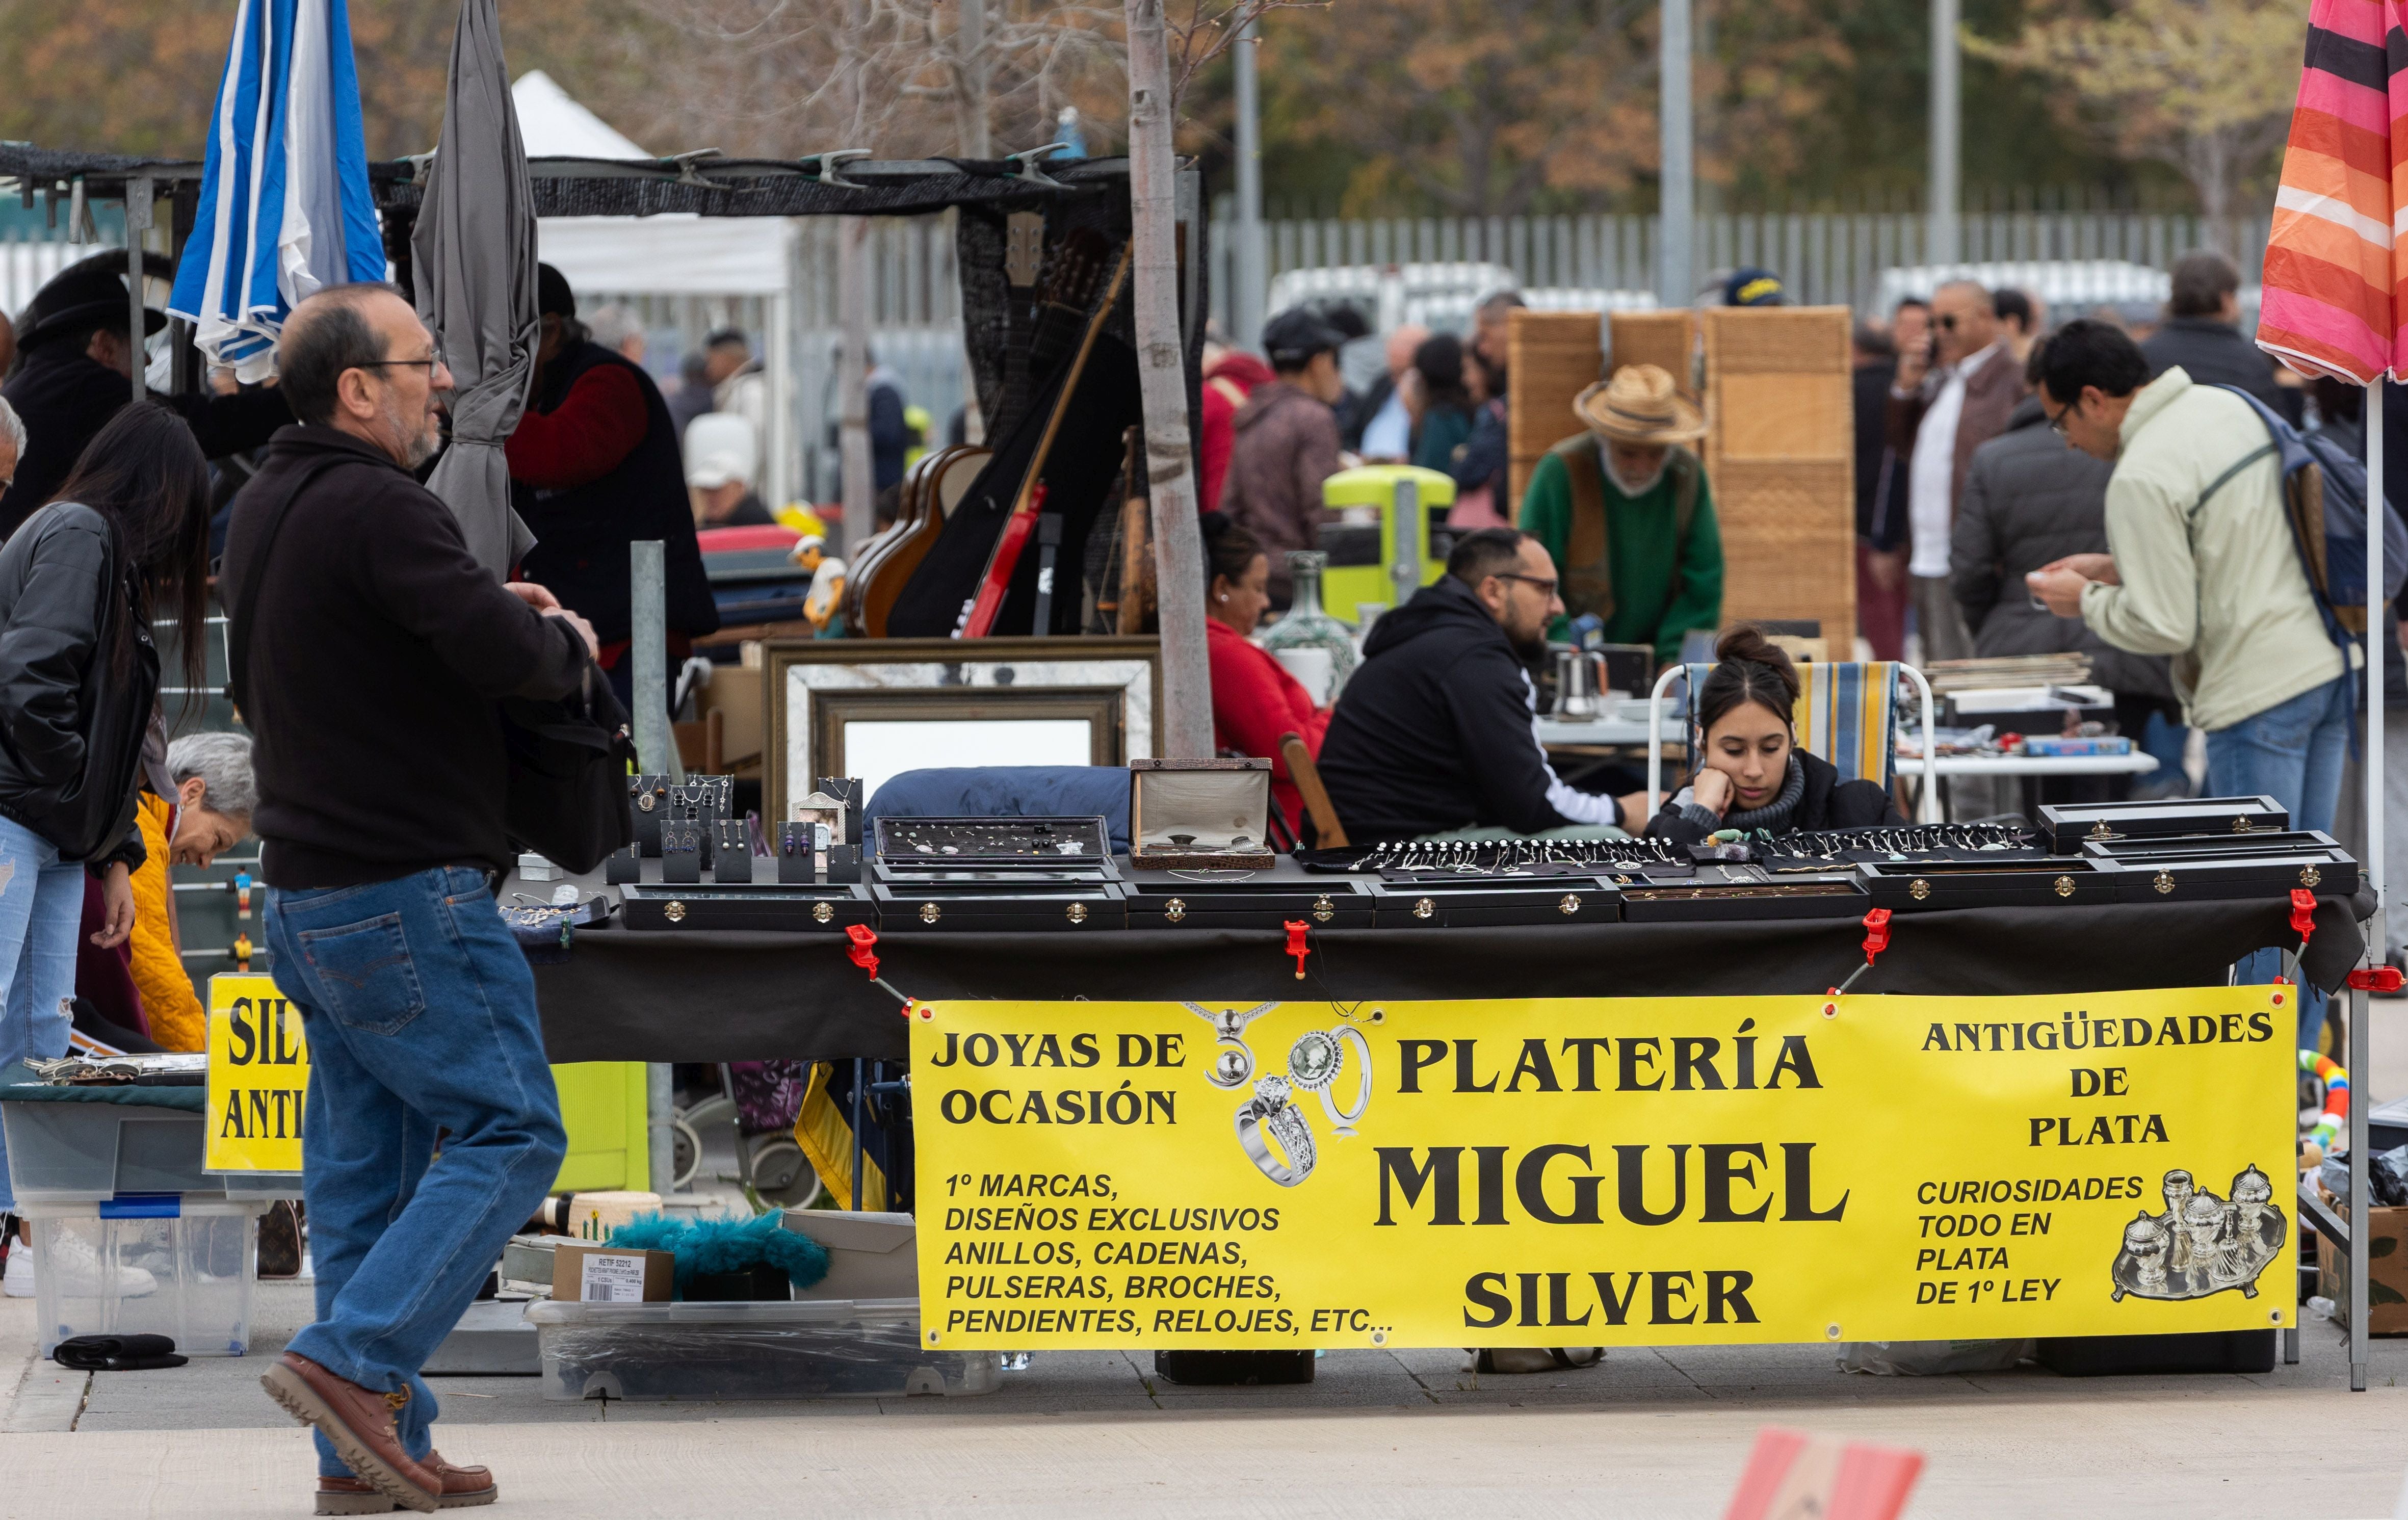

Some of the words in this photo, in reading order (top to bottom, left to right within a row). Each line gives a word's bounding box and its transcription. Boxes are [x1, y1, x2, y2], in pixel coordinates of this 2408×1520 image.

[228, 997, 311, 1066] SIL
[1921, 1011, 2273, 1051] ANTIGÜEDADES
[930, 1033, 1100, 1068] JOYAS
[1116, 1033, 1186, 1067] DE
[1396, 1017, 1824, 1093] PLATERÍA
[2070, 1067, 2129, 1097] DE
[940, 1080, 1177, 1125] OCASIÓN
[2028, 1114, 2170, 1147] PLATA
[979, 1174, 1117, 1201] MARCAS,
[1373, 1142, 1850, 1226] MIGUEL
[1917, 1176, 2143, 1204] CURIOSIDADES
[945, 1202, 1079, 1231] DISEÑOS
[1087, 1208, 1280, 1231] EXCLUSIVOS
[1918, 1214, 2001, 1238] TODO
[2010, 1212, 2052, 1236] EN
[944, 1241, 1081, 1269] ANILLOS,
[1094, 1242, 1247, 1269] CADENAS,
[1916, 1247, 2009, 1271] PLATA
[946, 1275, 1113, 1303] PULSERAS,
[1124, 1275, 1280, 1302] BROCHES,
[1463, 1270, 1761, 1328] SILVER
[1916, 1281, 1958, 1304] DE
[2002, 1278, 2061, 1302] LEY
[947, 1309, 1141, 1336] PENDIENTES,
[1153, 1309, 1299, 1336] RELOJES,
[1311, 1308, 1392, 1332] ETC...
